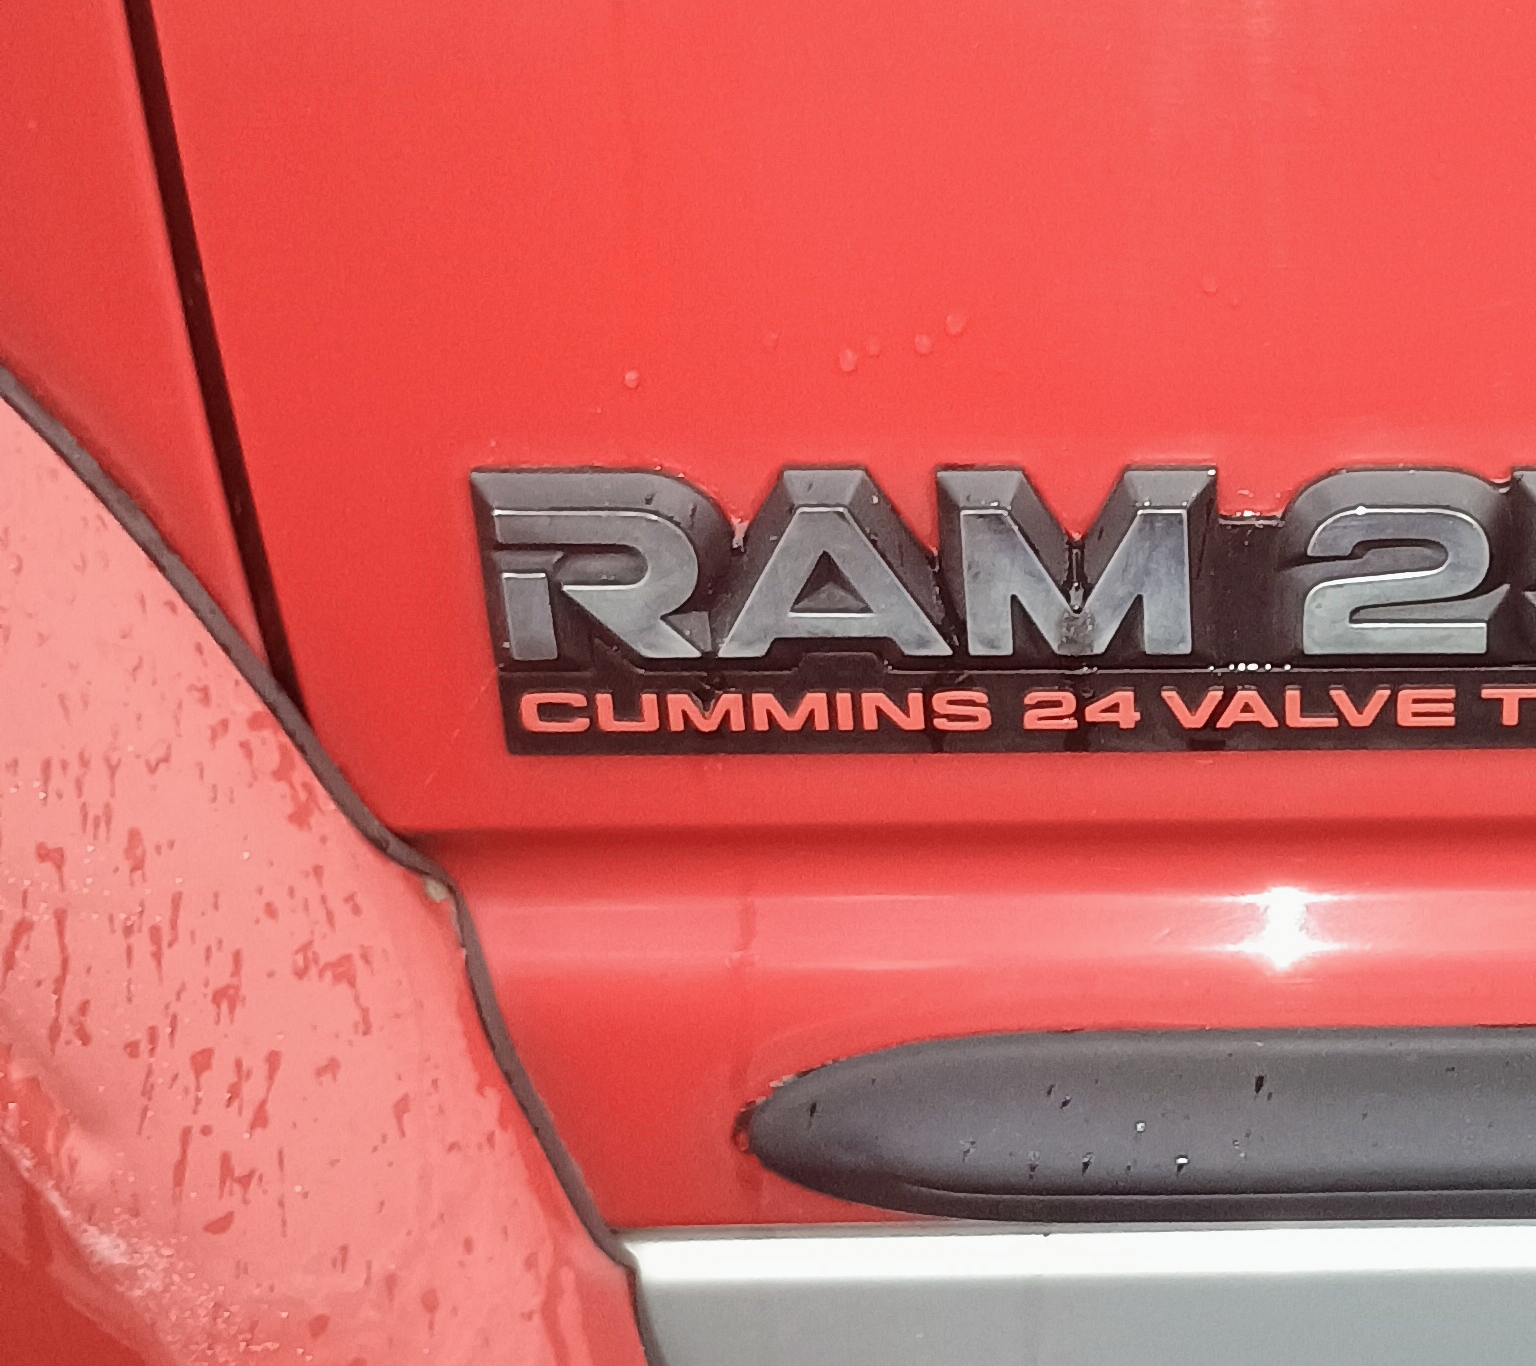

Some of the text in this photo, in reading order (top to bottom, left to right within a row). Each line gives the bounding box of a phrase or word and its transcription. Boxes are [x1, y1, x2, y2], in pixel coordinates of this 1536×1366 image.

[472, 469, 1214, 663] RAM
[518, 689, 994, 733] CUMMINS
[1021, 689, 1142, 730] 24
[1160, 685, 1459, 731] VALVE
